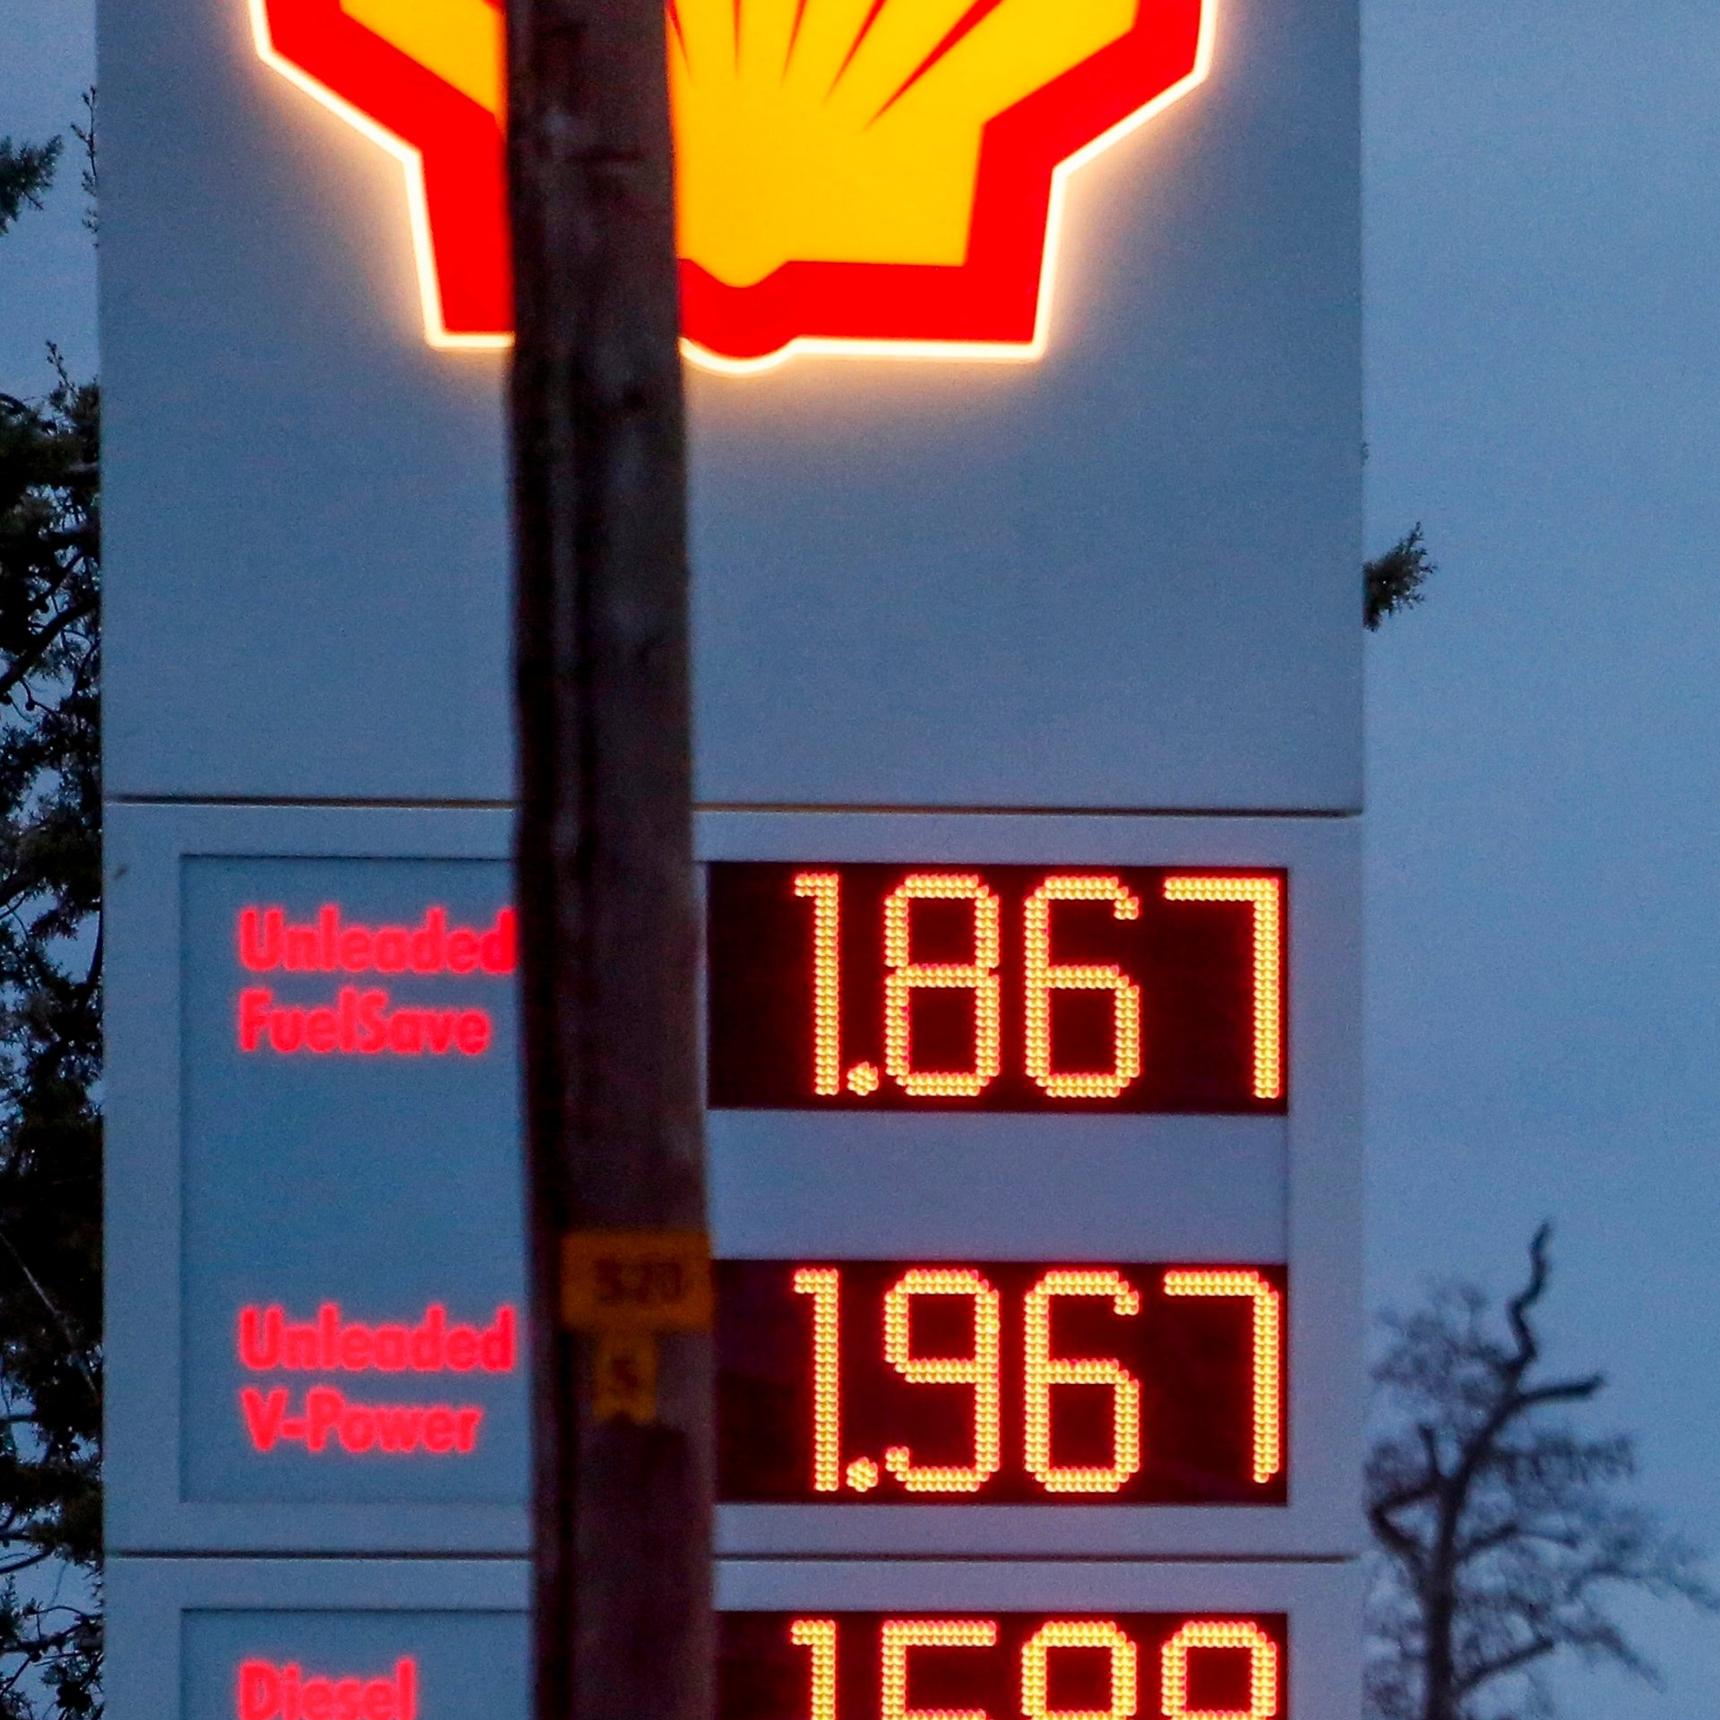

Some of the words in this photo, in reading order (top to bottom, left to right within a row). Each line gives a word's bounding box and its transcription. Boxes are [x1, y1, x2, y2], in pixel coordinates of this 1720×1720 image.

[238, 904, 516, 976] Unleaded
[238, 984, 492, 1056] FuelSave
[793, 873, 1281, 1100] 1.867
[238, 1302, 517, 1373] Unleaded
[793, 1268, 1281, 1494] 1.967
[240, 1385, 484, 1454] V-Power
